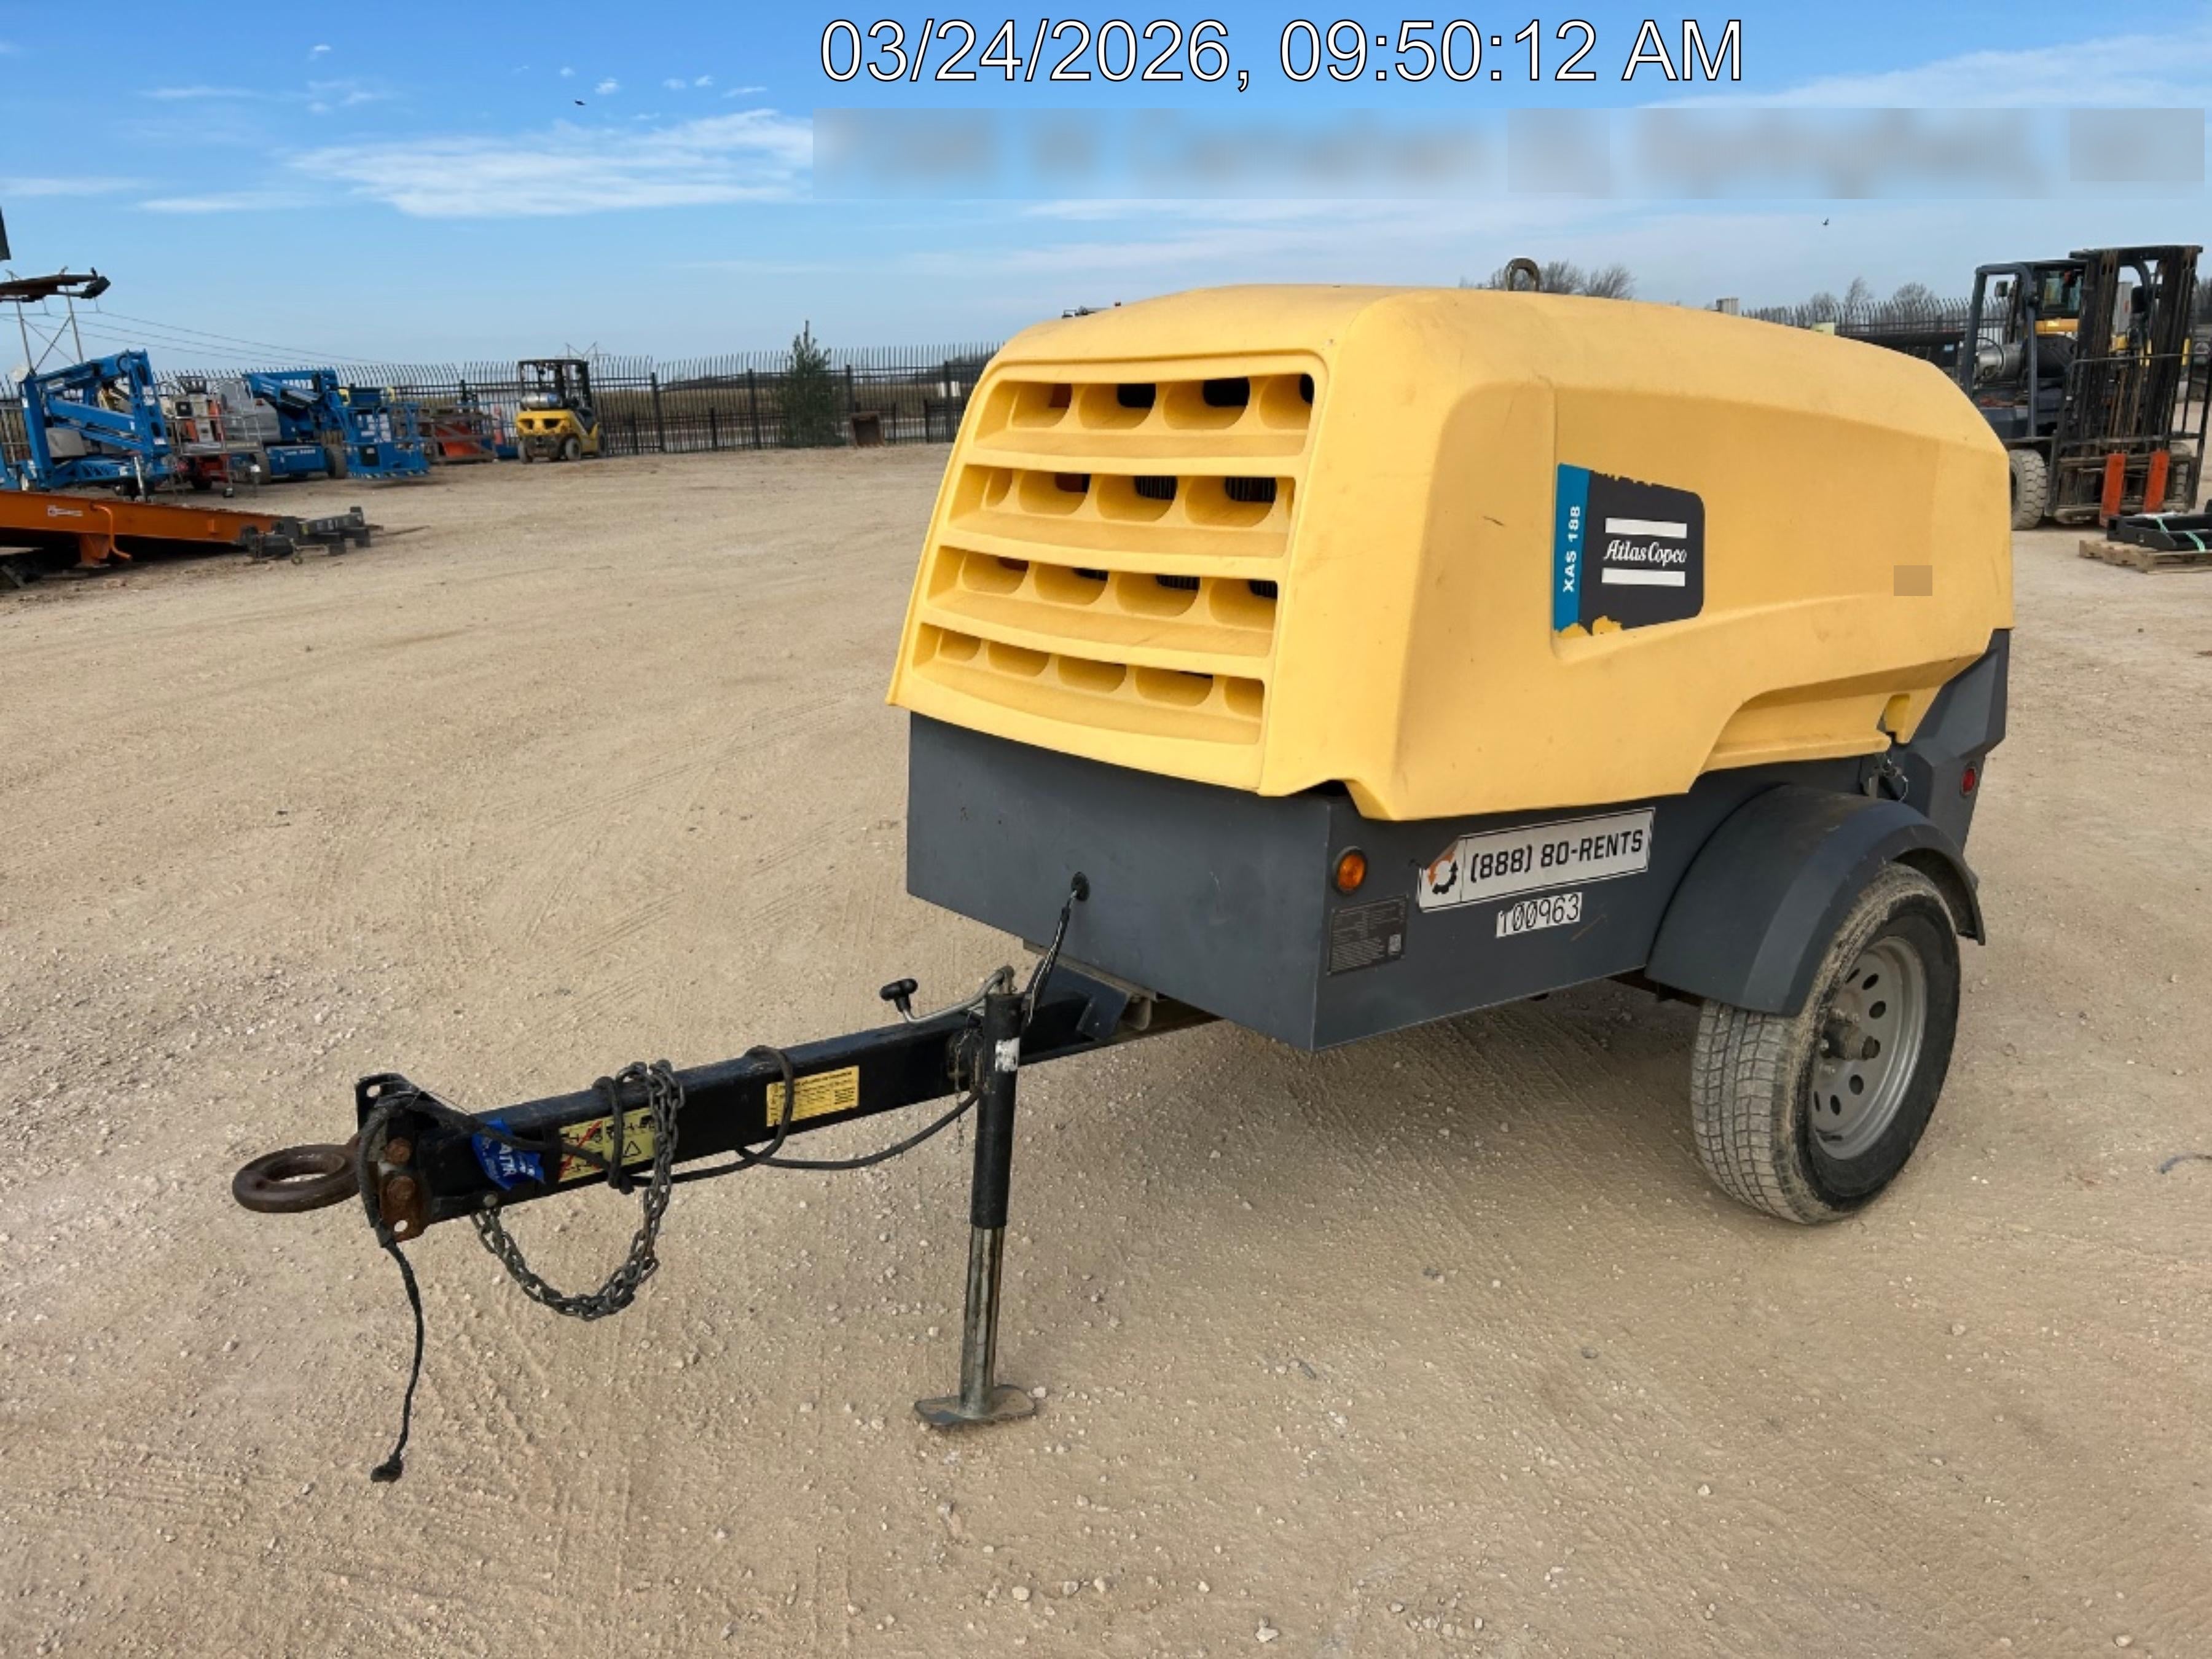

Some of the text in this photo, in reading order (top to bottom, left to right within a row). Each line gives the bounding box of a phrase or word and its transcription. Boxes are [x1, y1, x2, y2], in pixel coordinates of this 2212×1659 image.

[1563, 506, 1580, 592] XAS 188
[1470, 830, 1643, 884] (888) 80-RENTS
[1500, 893, 1579, 933] 100963
